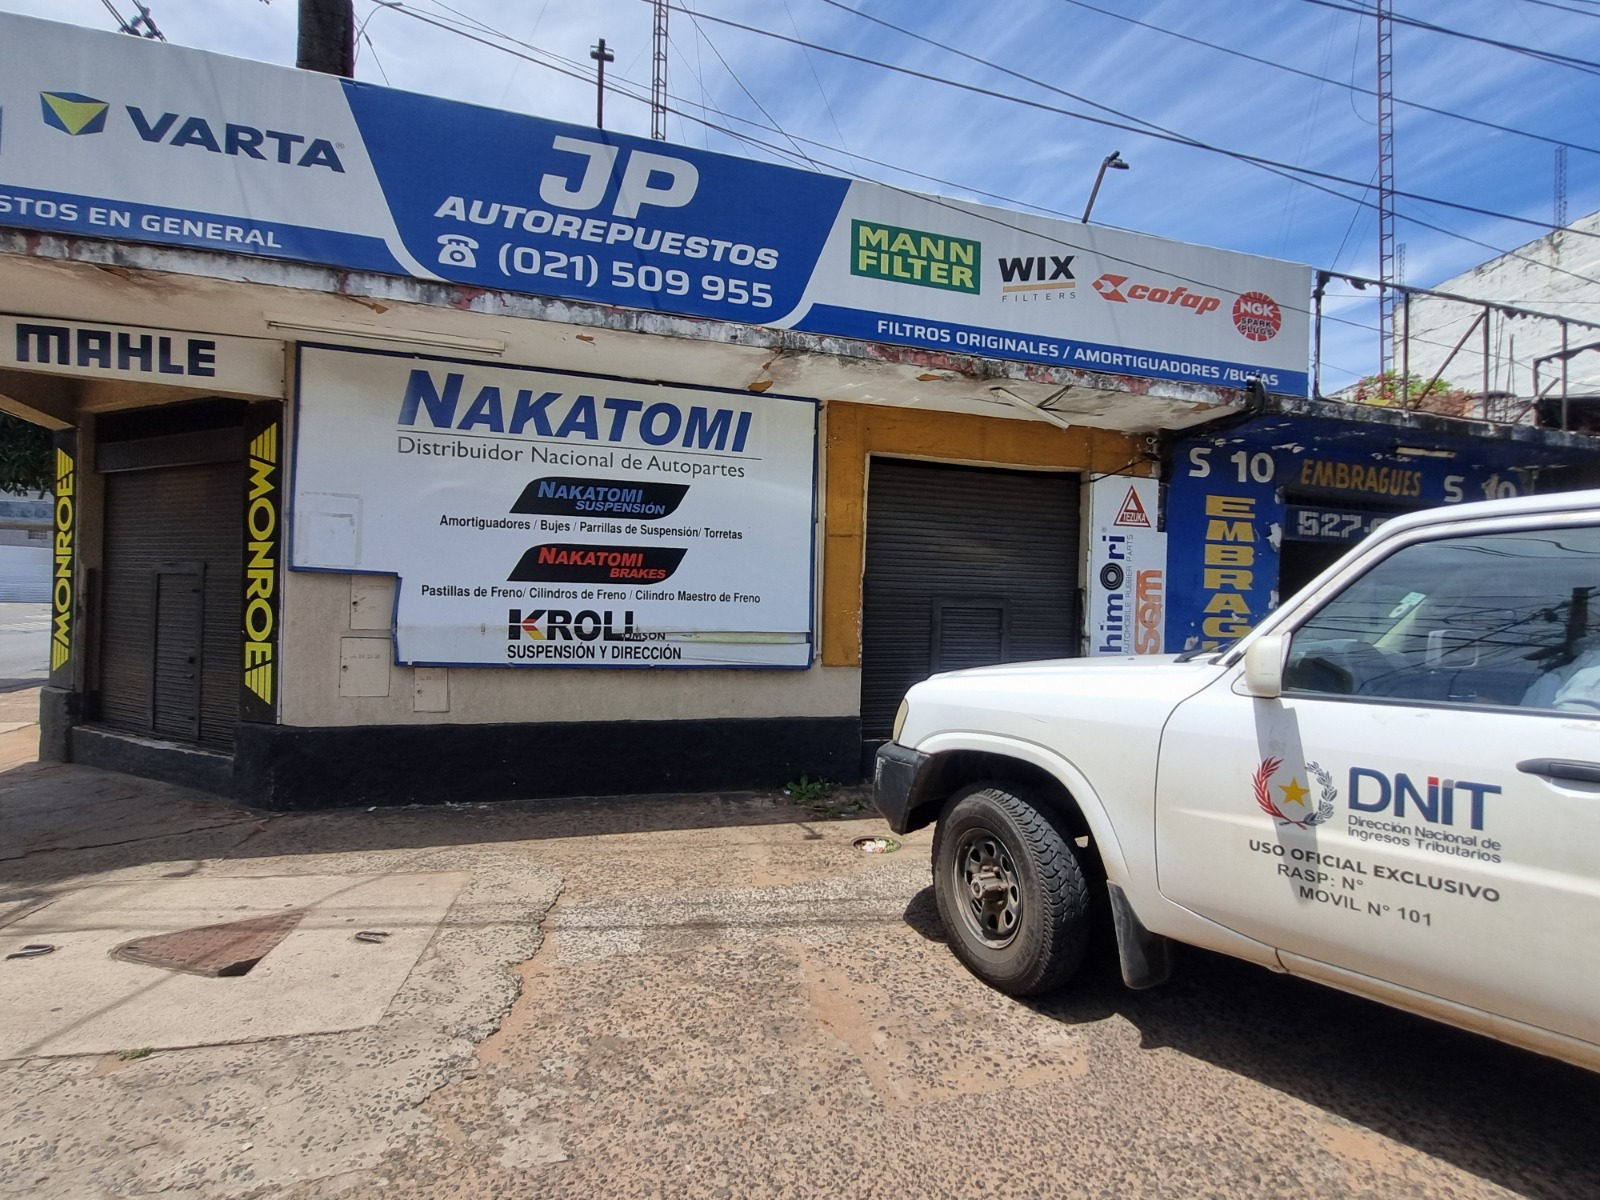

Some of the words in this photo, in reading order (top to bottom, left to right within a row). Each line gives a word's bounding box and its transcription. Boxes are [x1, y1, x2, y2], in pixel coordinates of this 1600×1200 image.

[125, 105, 345, 174] VARTA
[539, 135, 699, 219] JP
[89, 207, 130, 228] EN
[141, 215, 282, 248] GENERAL
[434, 196, 779, 270] AUTOREPUESTOS
[858, 225, 974, 265] MANN
[499, 243, 599, 287] (021)
[611, 261, 690, 295] 509
[701, 275, 773, 308] 955
[858, 250, 974, 288] FILTER
[998, 255, 1075, 282] WIX
[1001, 292, 1076, 303] FILTERS
[1127, 284, 1221, 315] cofap
[1240, 301, 1274, 318] NGK
[1241, 317, 1272, 328] SPARK
[1241, 325, 1274, 337] PLUGS
[16, 323, 216, 377] MAHLE
[877, 320, 951, 343] FILTROS
[956, 330, 1059, 359] ORIGINALES
[1074, 347, 1220, 379] AMORTIGUADORES
[397, 369, 753, 453] NAKATOMI
[398, 436, 524, 462] Distribuidor
[531, 447, 614, 469] Nacional
[621, 455, 643, 470] de
[646, 455, 746, 478] Autopartes
[1188, 447, 1212, 478] S
[1231, 450, 1275, 483] 10
[538, 481, 644, 503] NAKATOMI
[1301, 459, 1422, 498] EMBRAGUES
[1443, 475, 1465, 503] S
[575, 499, 666, 515] SUSPENSIÓN
[1123, 512, 1147, 523] TEZUKA
[440, 515, 531, 531] Amortiguadores
[541, 520, 571, 534] Bujes
[580, 521, 622, 534] Parrillas
[625, 524, 637, 534] de
[704, 528, 743, 540] Torretas
[54, 471, 74, 648] MONROE
[246, 456, 276, 669] MONROE
[538, 547, 644, 568] NAKATOMI
[1126, 534, 1134, 562] PARTS
[610, 568, 666, 579] BRAKES
[421, 585, 471, 597] Pastillas
[473, 586, 488, 597] de
[529, 587, 578, 599] Cilindros
[581, 588, 594, 599] de
[597, 589, 627, 600] Freno
[635, 590, 675, 601] Cilindro
[678, 591, 717, 602] Maestro
[719, 591, 731, 602] de
[734, 592, 761, 603] Freno
[508, 609, 645, 643] KROLL
[1124, 601, 1132, 654] AUTOMOBILE
[507, 642, 595, 660] SUSPENSIÓN
[599, 645, 608, 659] Y
[611, 644, 682, 660] DIRECCIÓN
[1347, 826, 1410, 847] Ingresos
[1414, 838, 1502, 864] Tributarios
[1348, 814, 1412, 836] Dirección
[1414, 826, 1477, 847] Nacional
[1480, 837, 1502, 851] de
[1249, 839, 1285, 857] USO
[1290, 848, 1367, 875] OFICIAL
[1373, 865, 1500, 902] EXCLUSIVO
[1277, 863, 1335, 888] RASP:
[1299, 886, 1361, 912] MOVIL
[1397, 906, 1432, 927] 101
